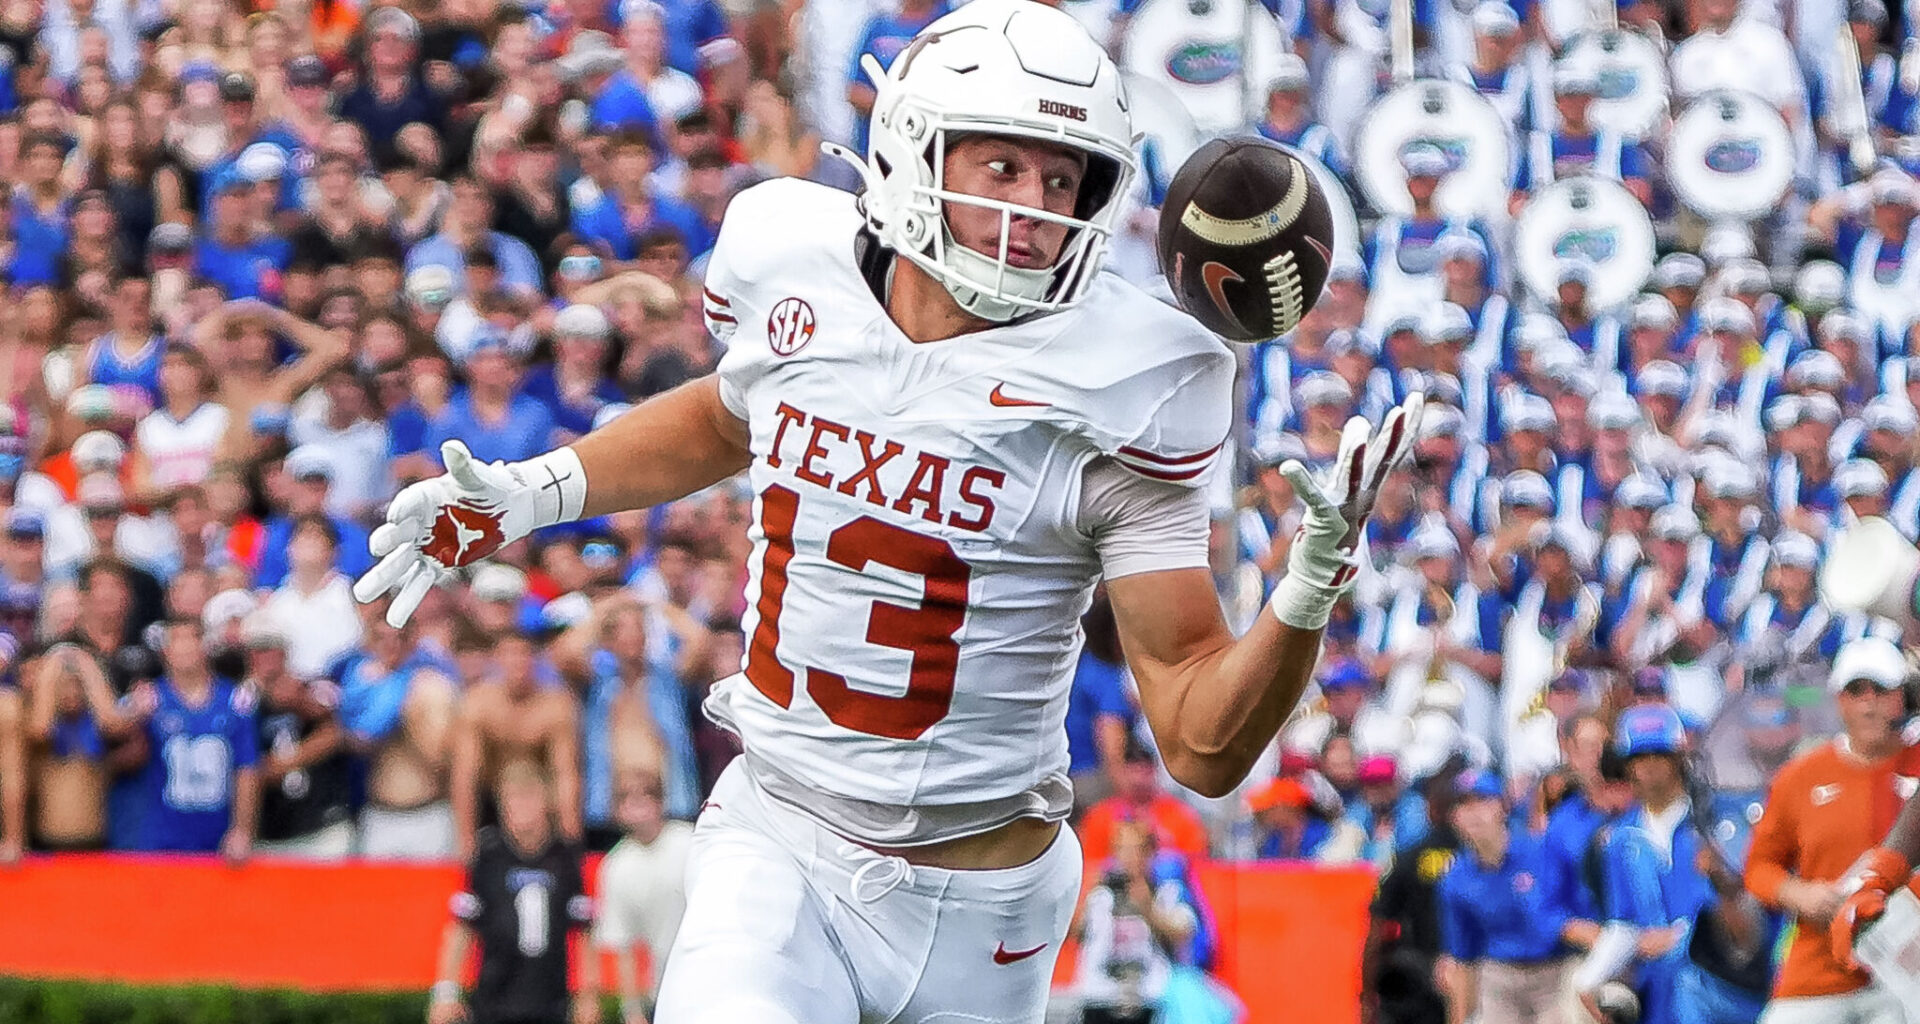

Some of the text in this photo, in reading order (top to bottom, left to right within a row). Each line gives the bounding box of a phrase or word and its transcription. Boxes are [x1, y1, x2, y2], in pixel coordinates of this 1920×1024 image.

[1038, 98, 1087, 122] HORNS
[768, 297, 816, 356] SEC
[766, 401, 1006, 532] TEXAS
[743, 482, 973, 740] 13
[514, 882, 549, 957] 1
